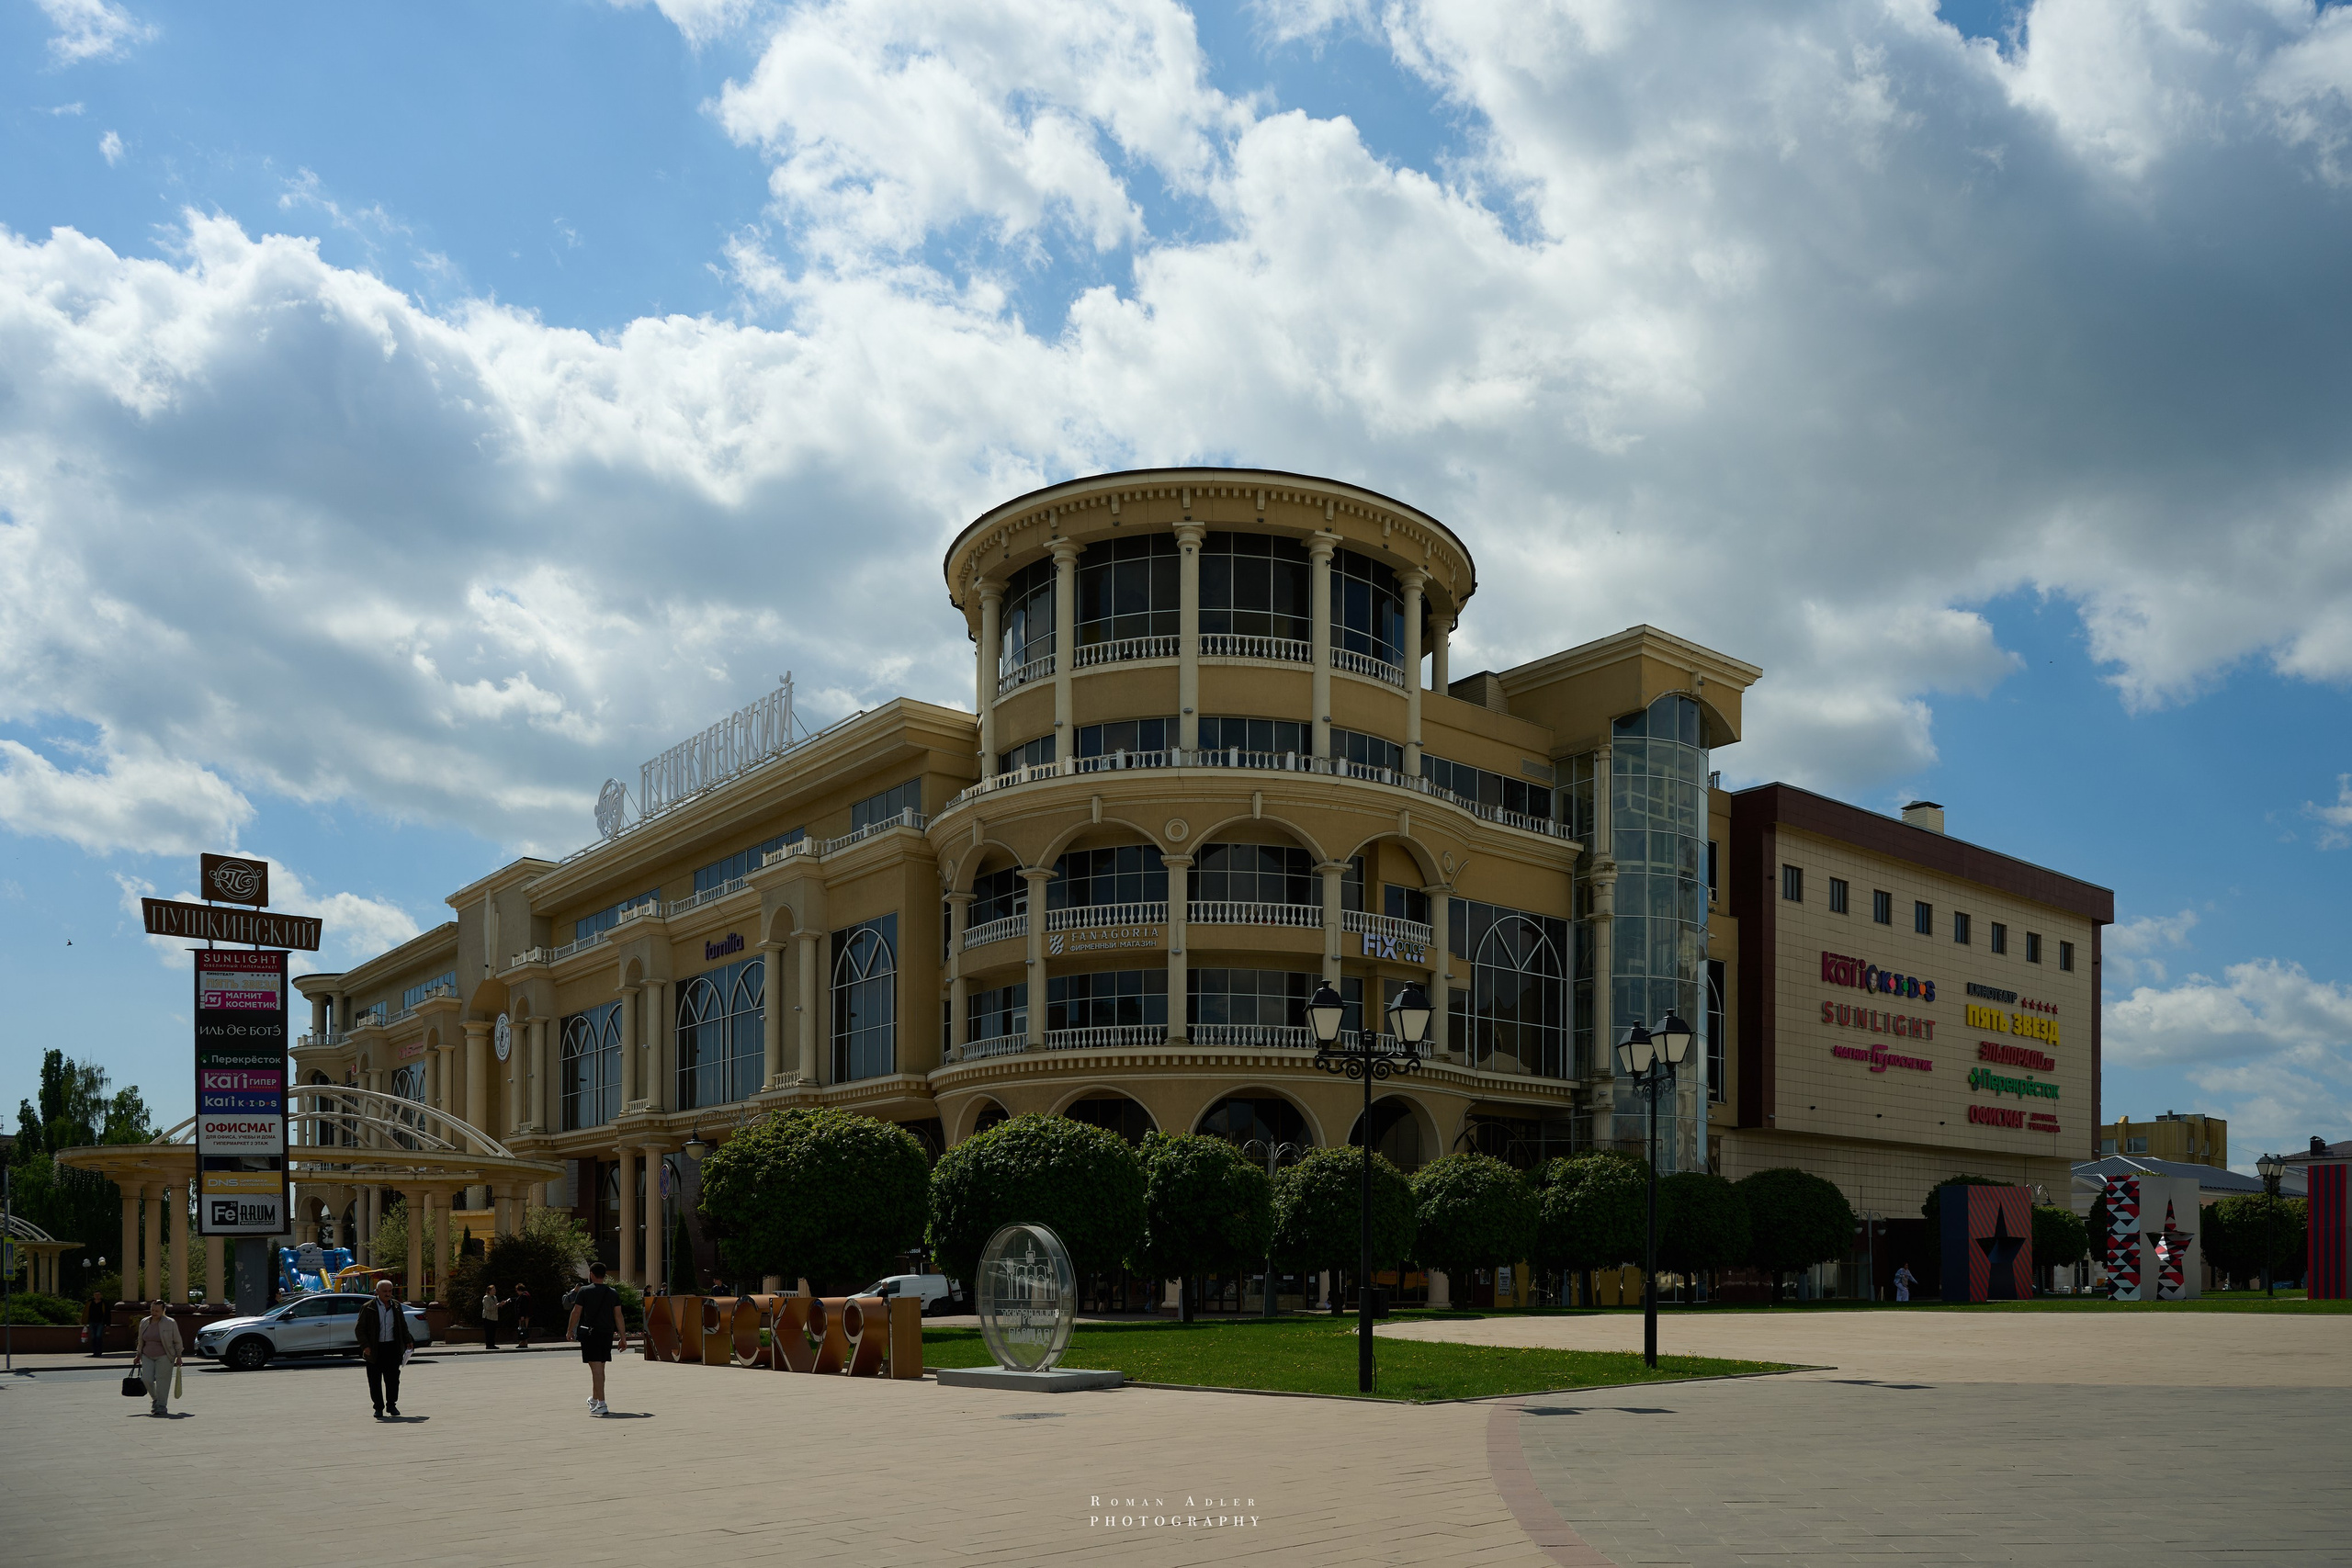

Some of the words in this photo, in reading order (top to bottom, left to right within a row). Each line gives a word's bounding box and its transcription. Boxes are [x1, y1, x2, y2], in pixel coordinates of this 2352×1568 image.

[151, 905, 317, 948] ПУШКИНСКИЙ
[1071, 928, 1159, 942] FANAGORIA
[1069, 942, 1116, 952] ФИРМЕННЫЙ
[1119, 940, 1157, 948] МАГАЗИН
[1396, 940, 1426, 955] price
[204, 953, 278, 964] SUNLIGHT
[1822, 951, 1867, 989] kari
[206, 978, 239, 989] ПЯТЬ
[242, 979, 279, 991] ЗВЕЗД
[1967, 982, 2018, 1004] КИНОТЕАТР
[1822, 1001, 1936, 1040] SUNLIGHT
[1966, 1003, 2009, 1032] ПЯТЬ
[2012, 1012, 2060, 1046] ЗВЕЗД
[211, 1055, 282, 1066] Перекрёсток
[1832, 1044, 1871, 1061] МАГНИТ
[1888, 1053, 1934, 1072] КОСМЕТИК
[204, 1072, 248, 1089] kari
[1982, 1067, 2060, 1100] Перекрёсток
[205, 1095, 235, 1107] kari
[1969, 1104, 2027, 1129] ОФИСМАГ
[205, 1122, 277, 1133] ОФИСМАГ
[208, 1179, 239, 1187] DNS
